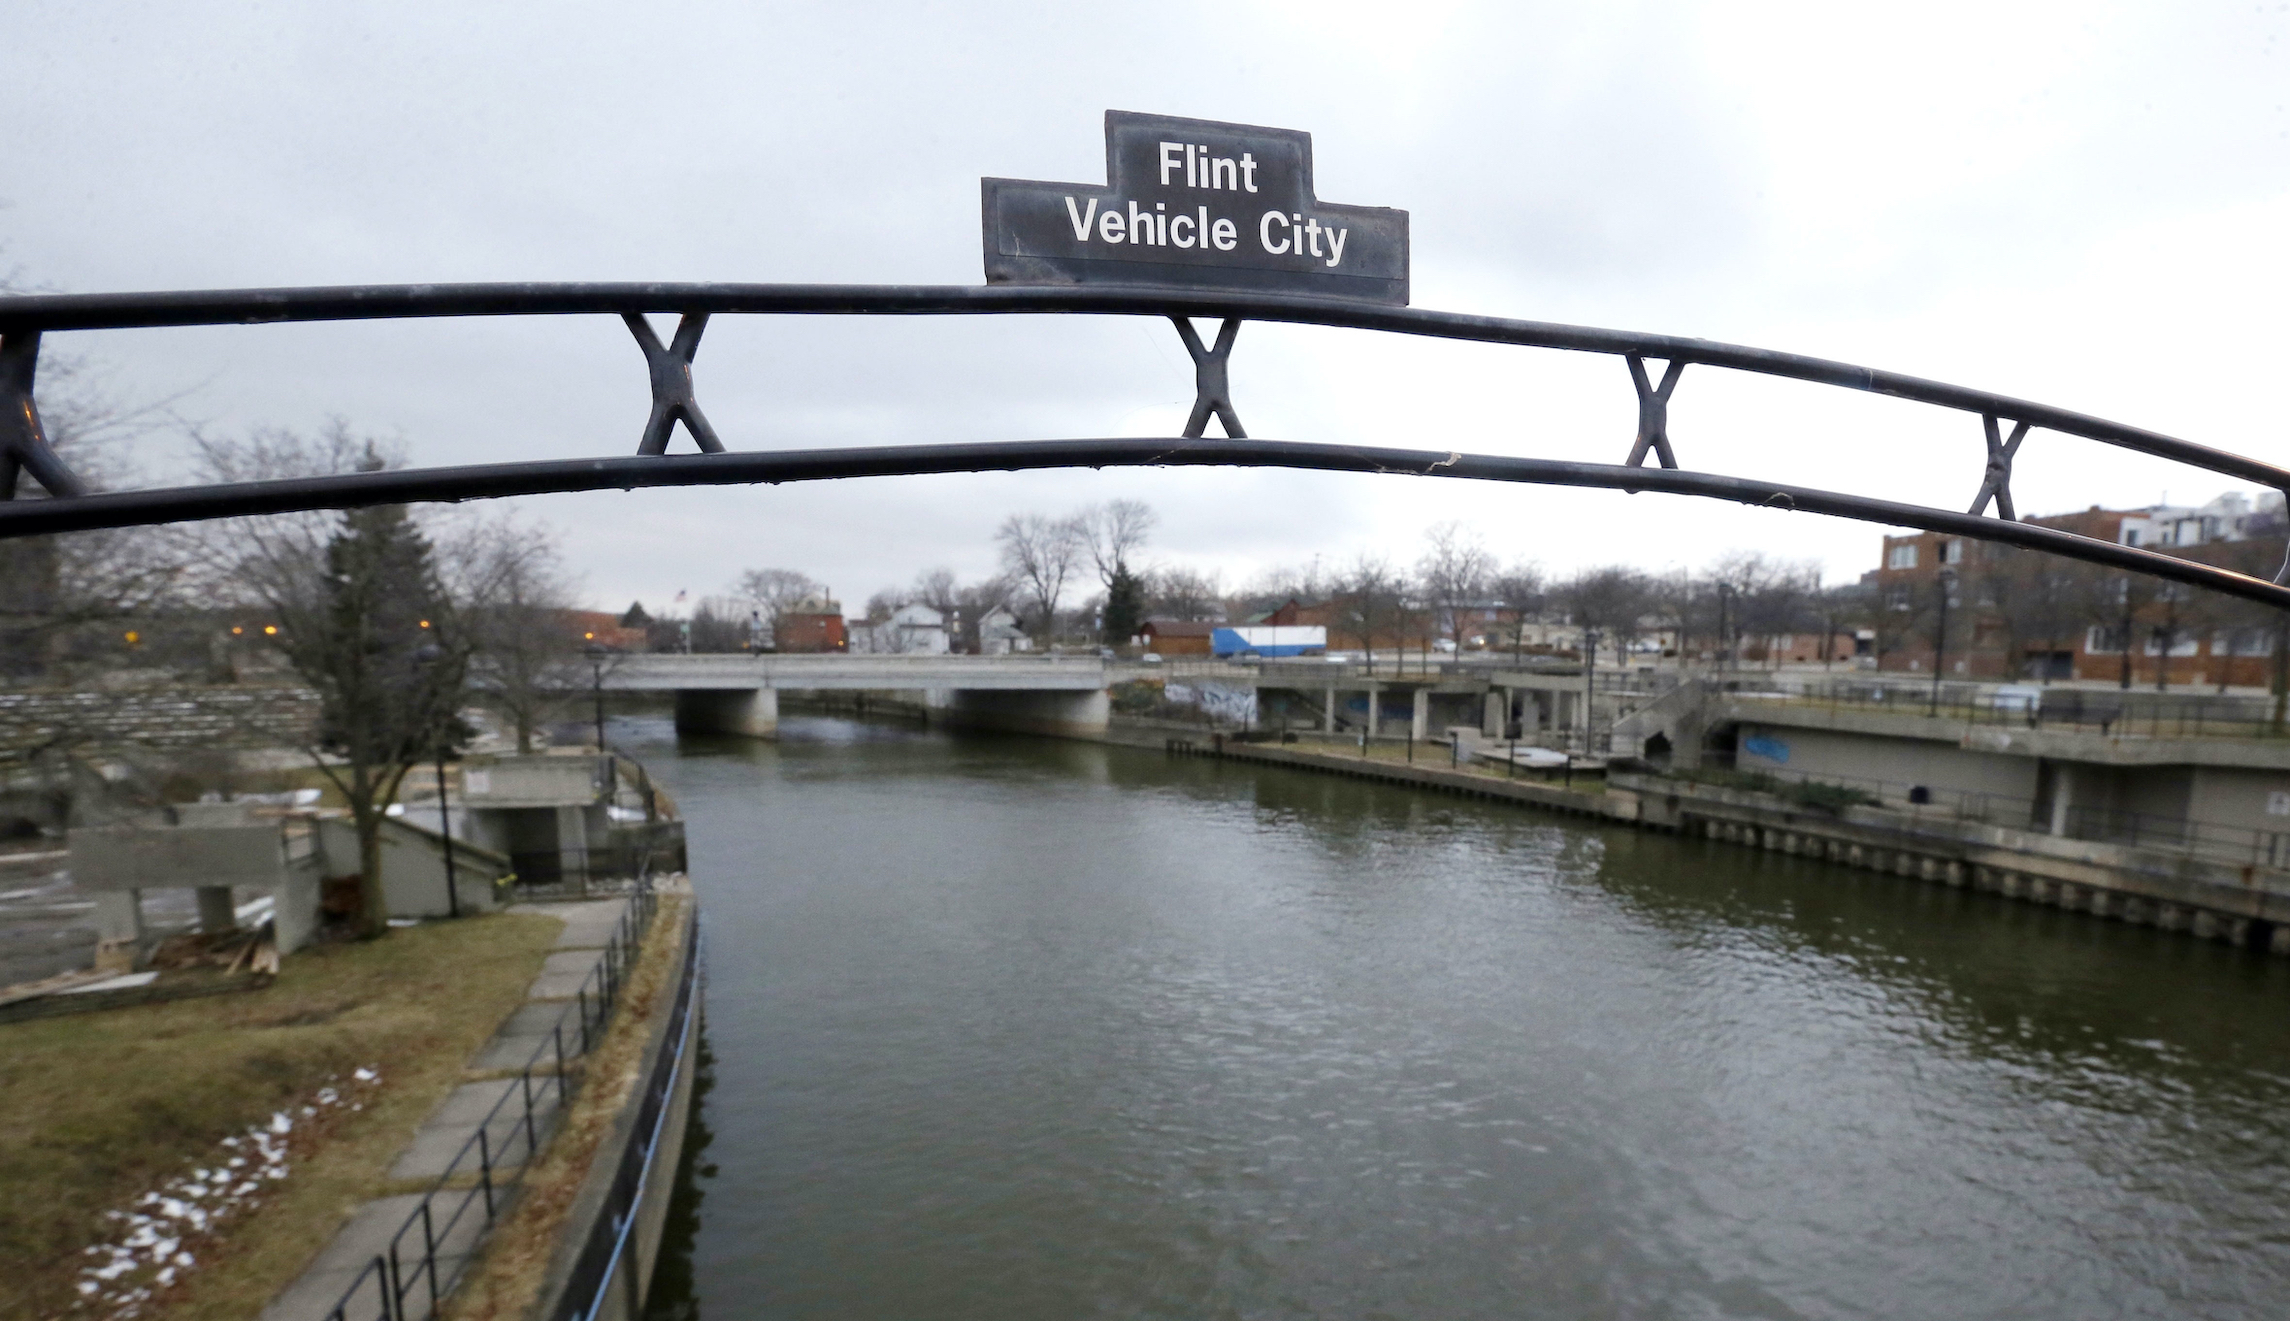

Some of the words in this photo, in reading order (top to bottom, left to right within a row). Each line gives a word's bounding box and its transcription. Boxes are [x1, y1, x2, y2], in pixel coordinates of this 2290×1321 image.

[1159, 141, 1259, 193] Flint
[1064, 196, 1238, 251] Vehicle
[1259, 210, 1348, 267] City
